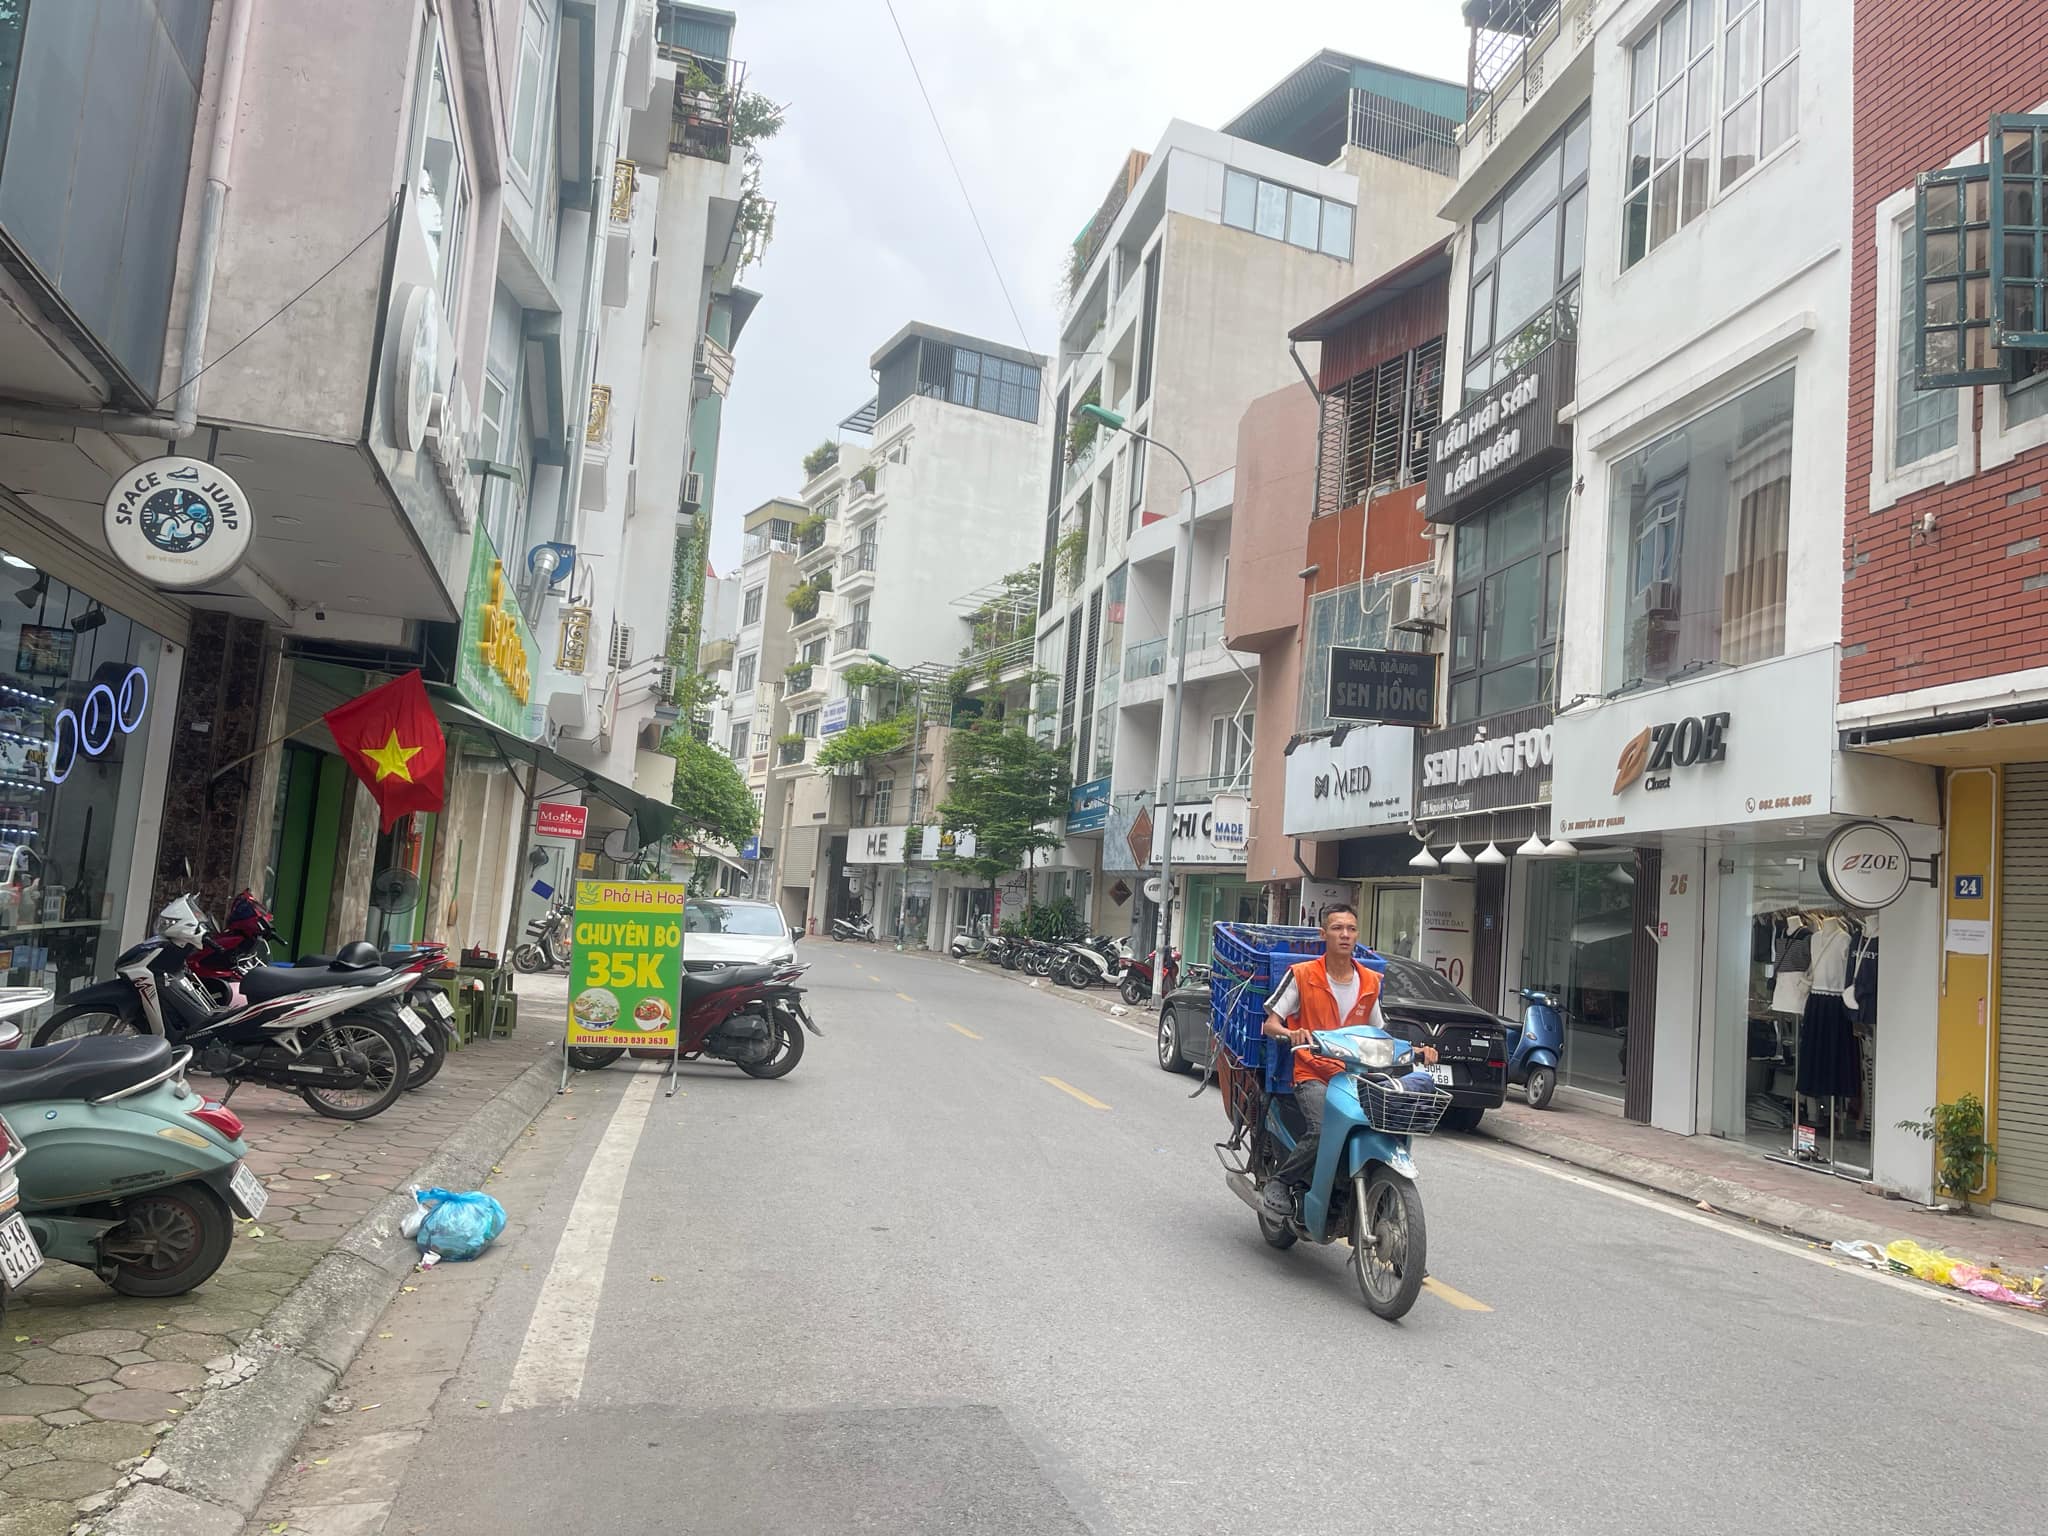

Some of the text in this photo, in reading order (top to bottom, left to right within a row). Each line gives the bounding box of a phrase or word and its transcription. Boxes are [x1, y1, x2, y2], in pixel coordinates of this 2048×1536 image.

[1468, 396, 1499, 444] HẢI
[1500, 373, 1539, 419] SẢN
[115, 472, 238, 531] SPACE JUMP
[1350, 656, 1377, 672] NHÀ
[1336, 678, 1428, 712] SEN HỒNG
[1645, 712, 1731, 772] ZOE
[1423, 749, 1458, 787] SEN
[1458, 726, 1513, 786] HỒNG
[1645, 777, 1671, 791] Closet
[540, 811, 584, 824] Moskva
[1215, 822, 1243, 835] MADE
[1861, 854, 1899, 870] ZOE
[603, 888, 684, 905] Phở Hà Hoa
[1669, 874, 1688, 895] 26
[1959, 879, 1977, 895] 24
[576, 920, 681, 948] CHUYÊN BÒ
[586, 951, 665, 989] 35K
[1434, 957, 1464, 987] 50
[6, 1244, 37, 1279] 9413
